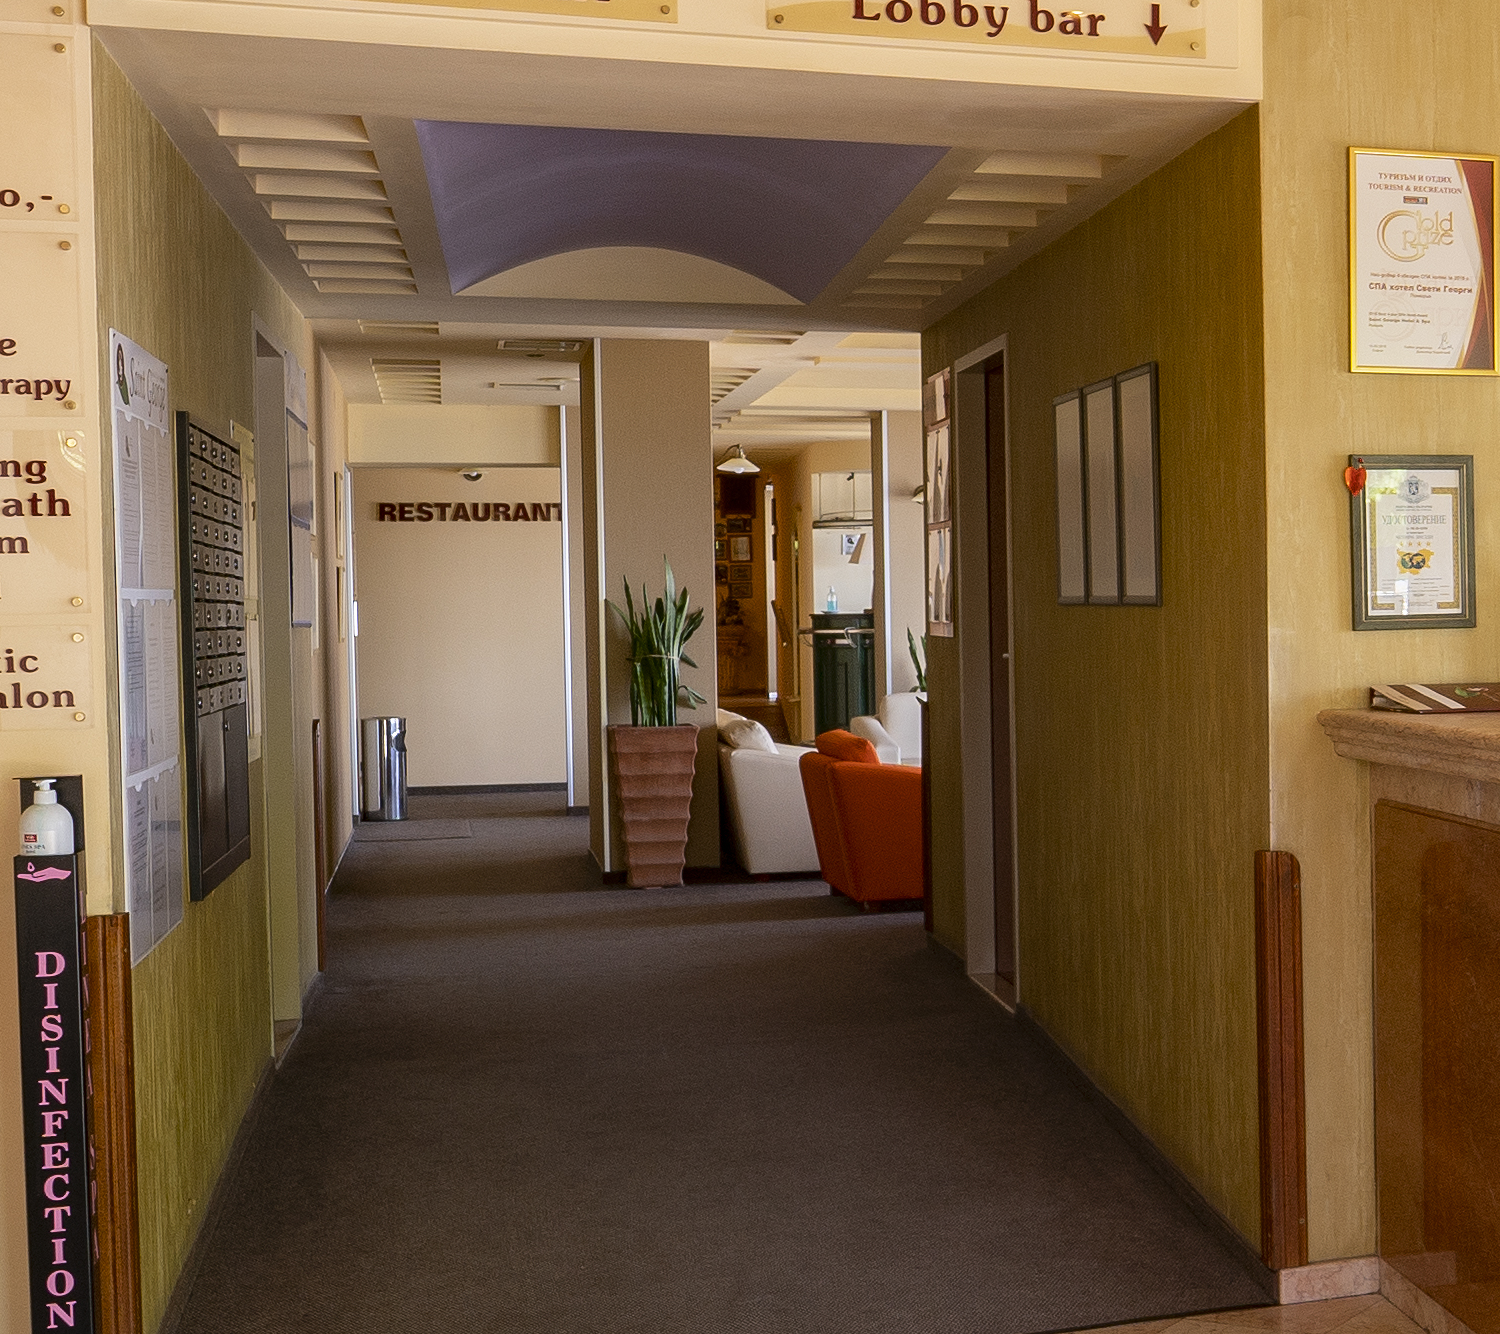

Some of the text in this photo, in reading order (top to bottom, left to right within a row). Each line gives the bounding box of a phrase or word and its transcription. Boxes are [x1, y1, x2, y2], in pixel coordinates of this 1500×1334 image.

[1379, 173, 1416, 181] ТУРИЗЪМ
[1425, 175, 1452, 183] ОТДИХ
[1368, 183, 1403, 191] TOURISM
[1413, 186, 1462, 194] RECREATION
[1402, 230, 1454, 250] prize
[1444, 286, 1472, 294] Георги
[379, 502, 562, 522] RESTAURANT
[1382, 515, 1447, 524] УДОСТОВЕРЕНИЕ
[35, 951, 77, 1329] DISINFECTION
